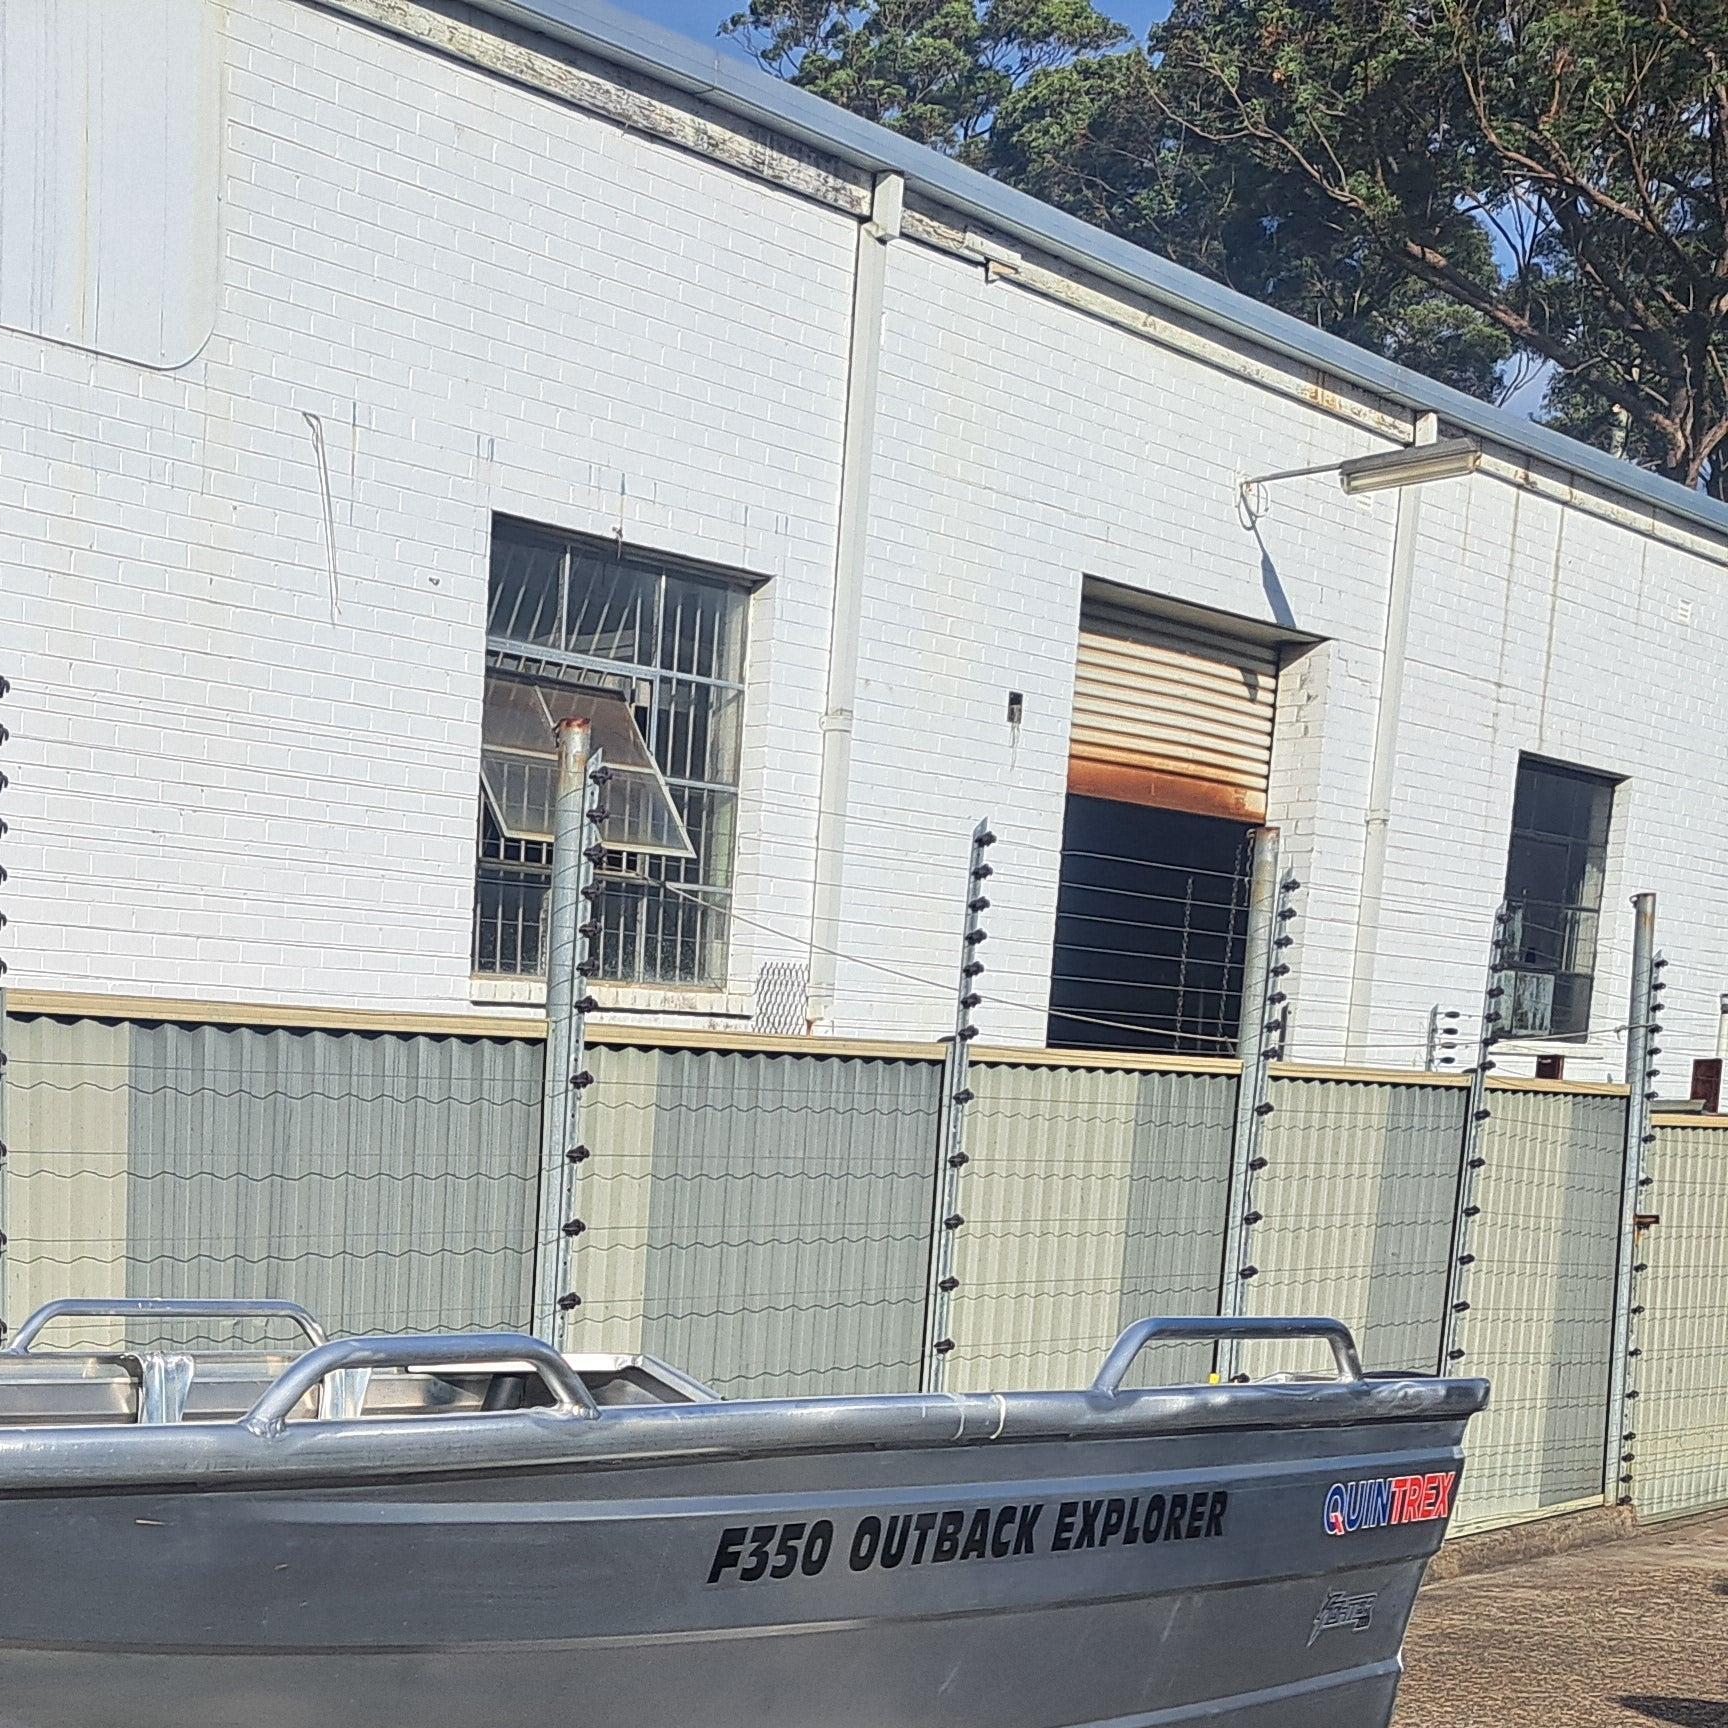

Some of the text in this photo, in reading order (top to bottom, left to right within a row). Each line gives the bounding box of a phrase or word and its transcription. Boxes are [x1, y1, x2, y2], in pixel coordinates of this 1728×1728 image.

[706, 1491, 1228, 1584] F350 OUTBACK EXPLORER
[1323, 1472, 1456, 1536] QUINTREX
